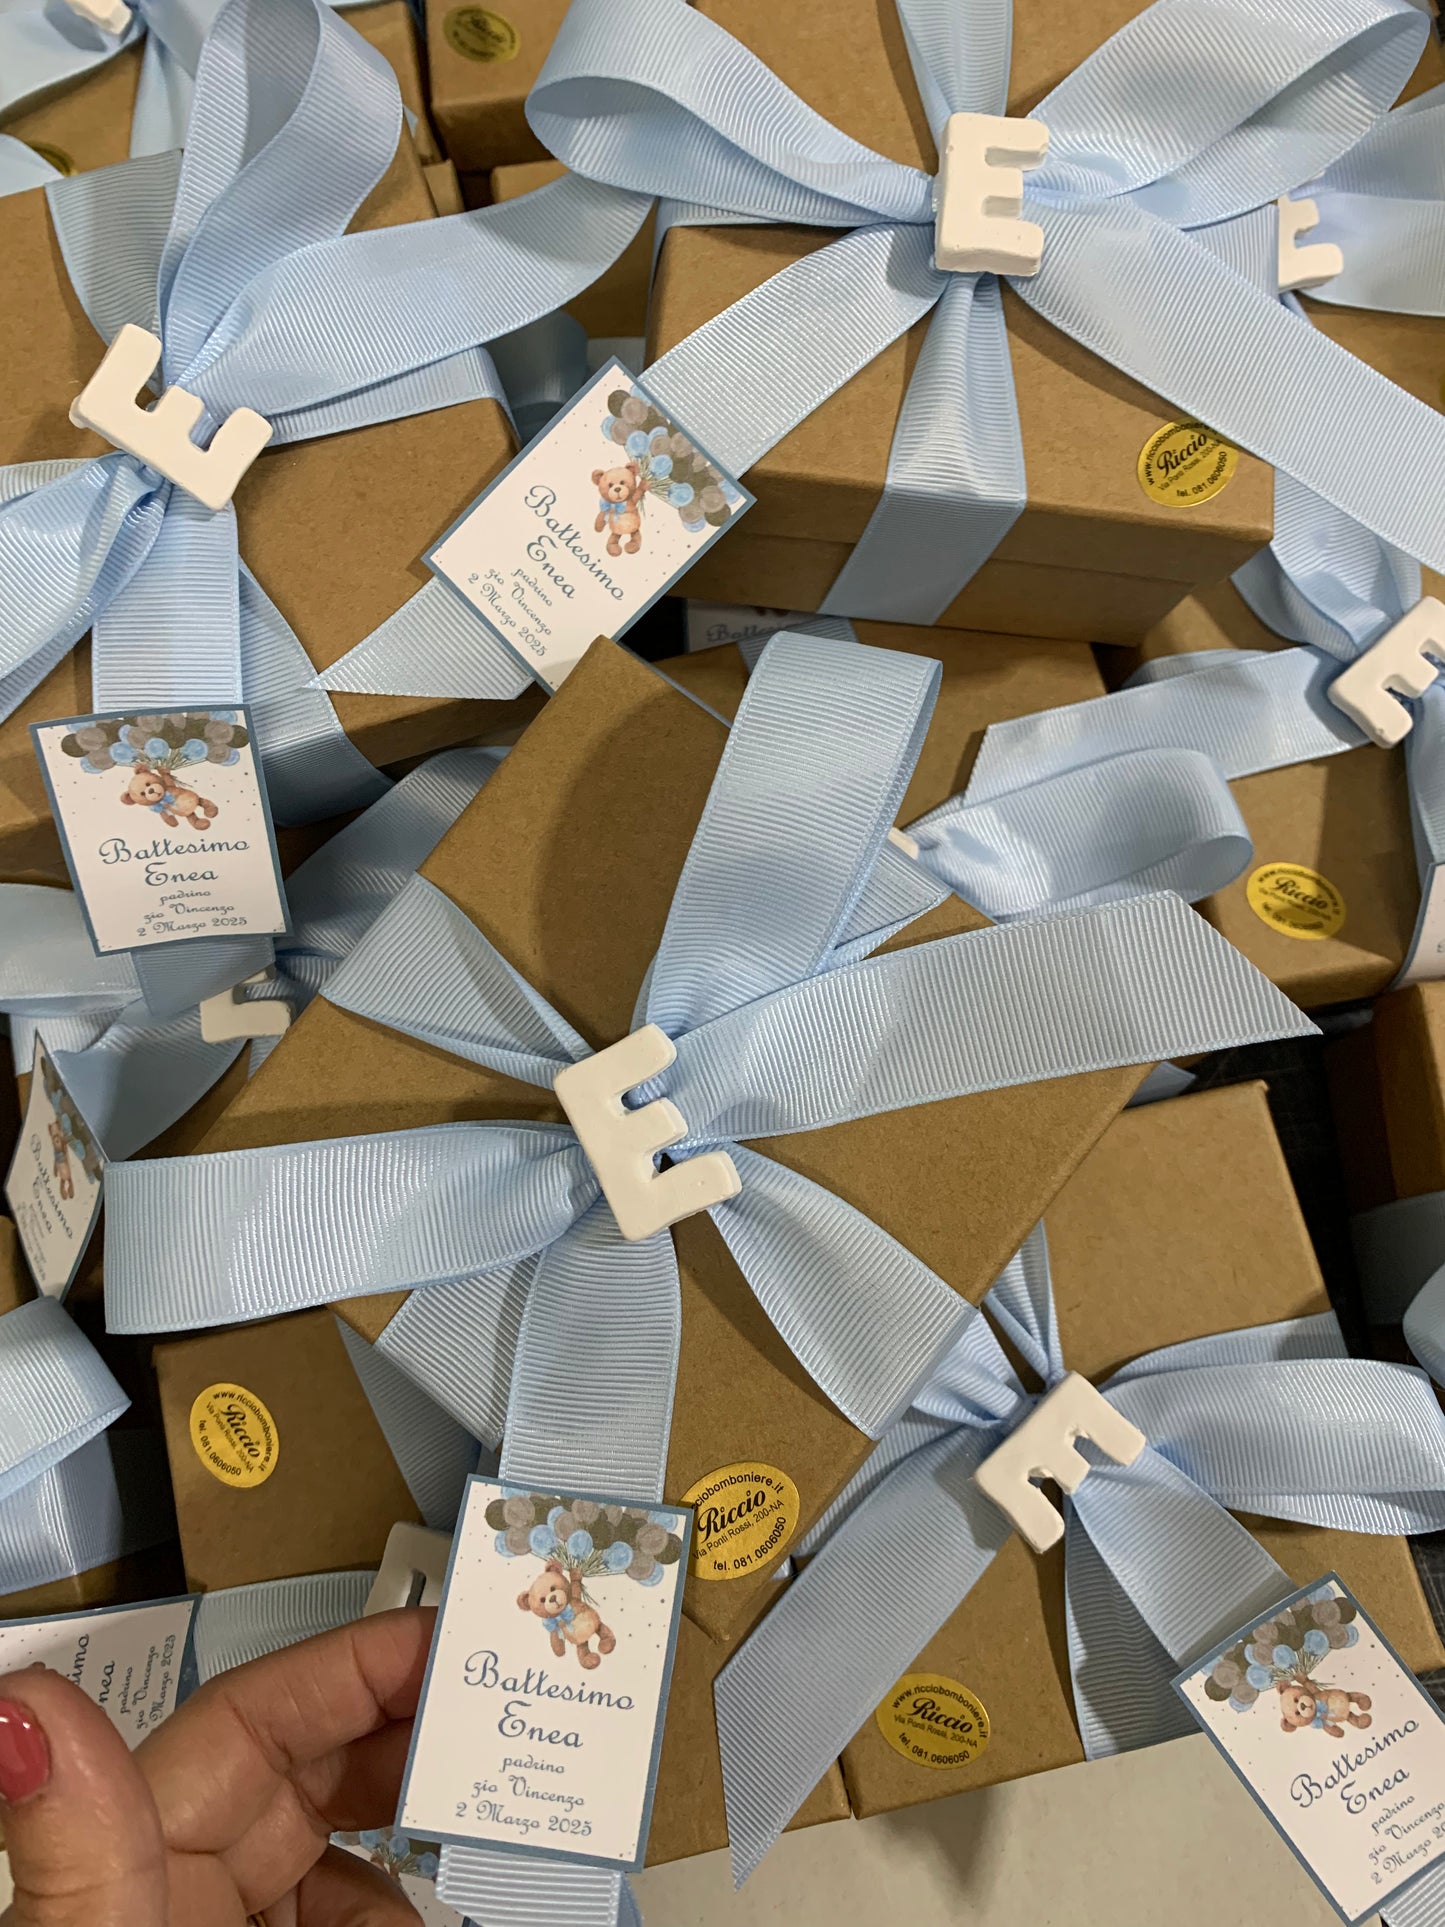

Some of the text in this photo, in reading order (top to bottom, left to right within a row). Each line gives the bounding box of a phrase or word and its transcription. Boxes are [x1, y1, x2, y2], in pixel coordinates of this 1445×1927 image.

[1156, 433, 1207, 479] Riccio
[524, 485, 625, 601] Battesimo
[510, 568, 553, 607] padrino
[526, 534, 576, 599] Enea
[467, 572, 547, 657] 2 Marzo 2025
[484, 568, 552, 636] zio Vincenzo
[98, 838, 250, 865] Battesimo
[145, 861, 219, 887] Enea
[143, 902, 235, 924] zio Vincenzo
[158, 889, 211, 907] padrino
[136, 916, 248, 937] 2 Marzo 2025
[218, 1404, 260, 1457] Riccio
[692, 1499, 785, 1560] Via Ponti Rossi, 200-NA
[697, 1490, 766, 1543] Riccio
[713, 1517, 786, 1571] tel. 081.0606050
[98, 1660, 116, 1706] nea
[120, 1666, 133, 1715] padrino
[132, 1646, 159, 1730] zio Vincenzo
[150, 1634, 176, 1721] Marzo 2025
[463, 1650, 635, 1710] Battesimo
[498, 1700, 583, 1748] Enea
[892, 1684, 988, 1738] www.ricciobomboniere.it
[894, 1713, 905, 1724] Via
[906, 1697, 973, 1733] Riccio
[498, 1754, 565, 1774] padrino
[899, 1732, 969, 1764] tel. 081.0606050
[1290, 1719, 1419, 1808] Battesimo
[471, 1774, 585, 1812] zio Vincenzo
[1340, 1768, 1410, 1814] Enea
[455, 1800, 593, 1836] 2 Marzo 2025
[1368, 1802, 1445, 1866] zio Vincenzo
[1370, 1795, 1415, 1836] padrino
[1370, 1872, 1383, 1885] 2
[1382, 1839, 1431, 1874] Marzo
